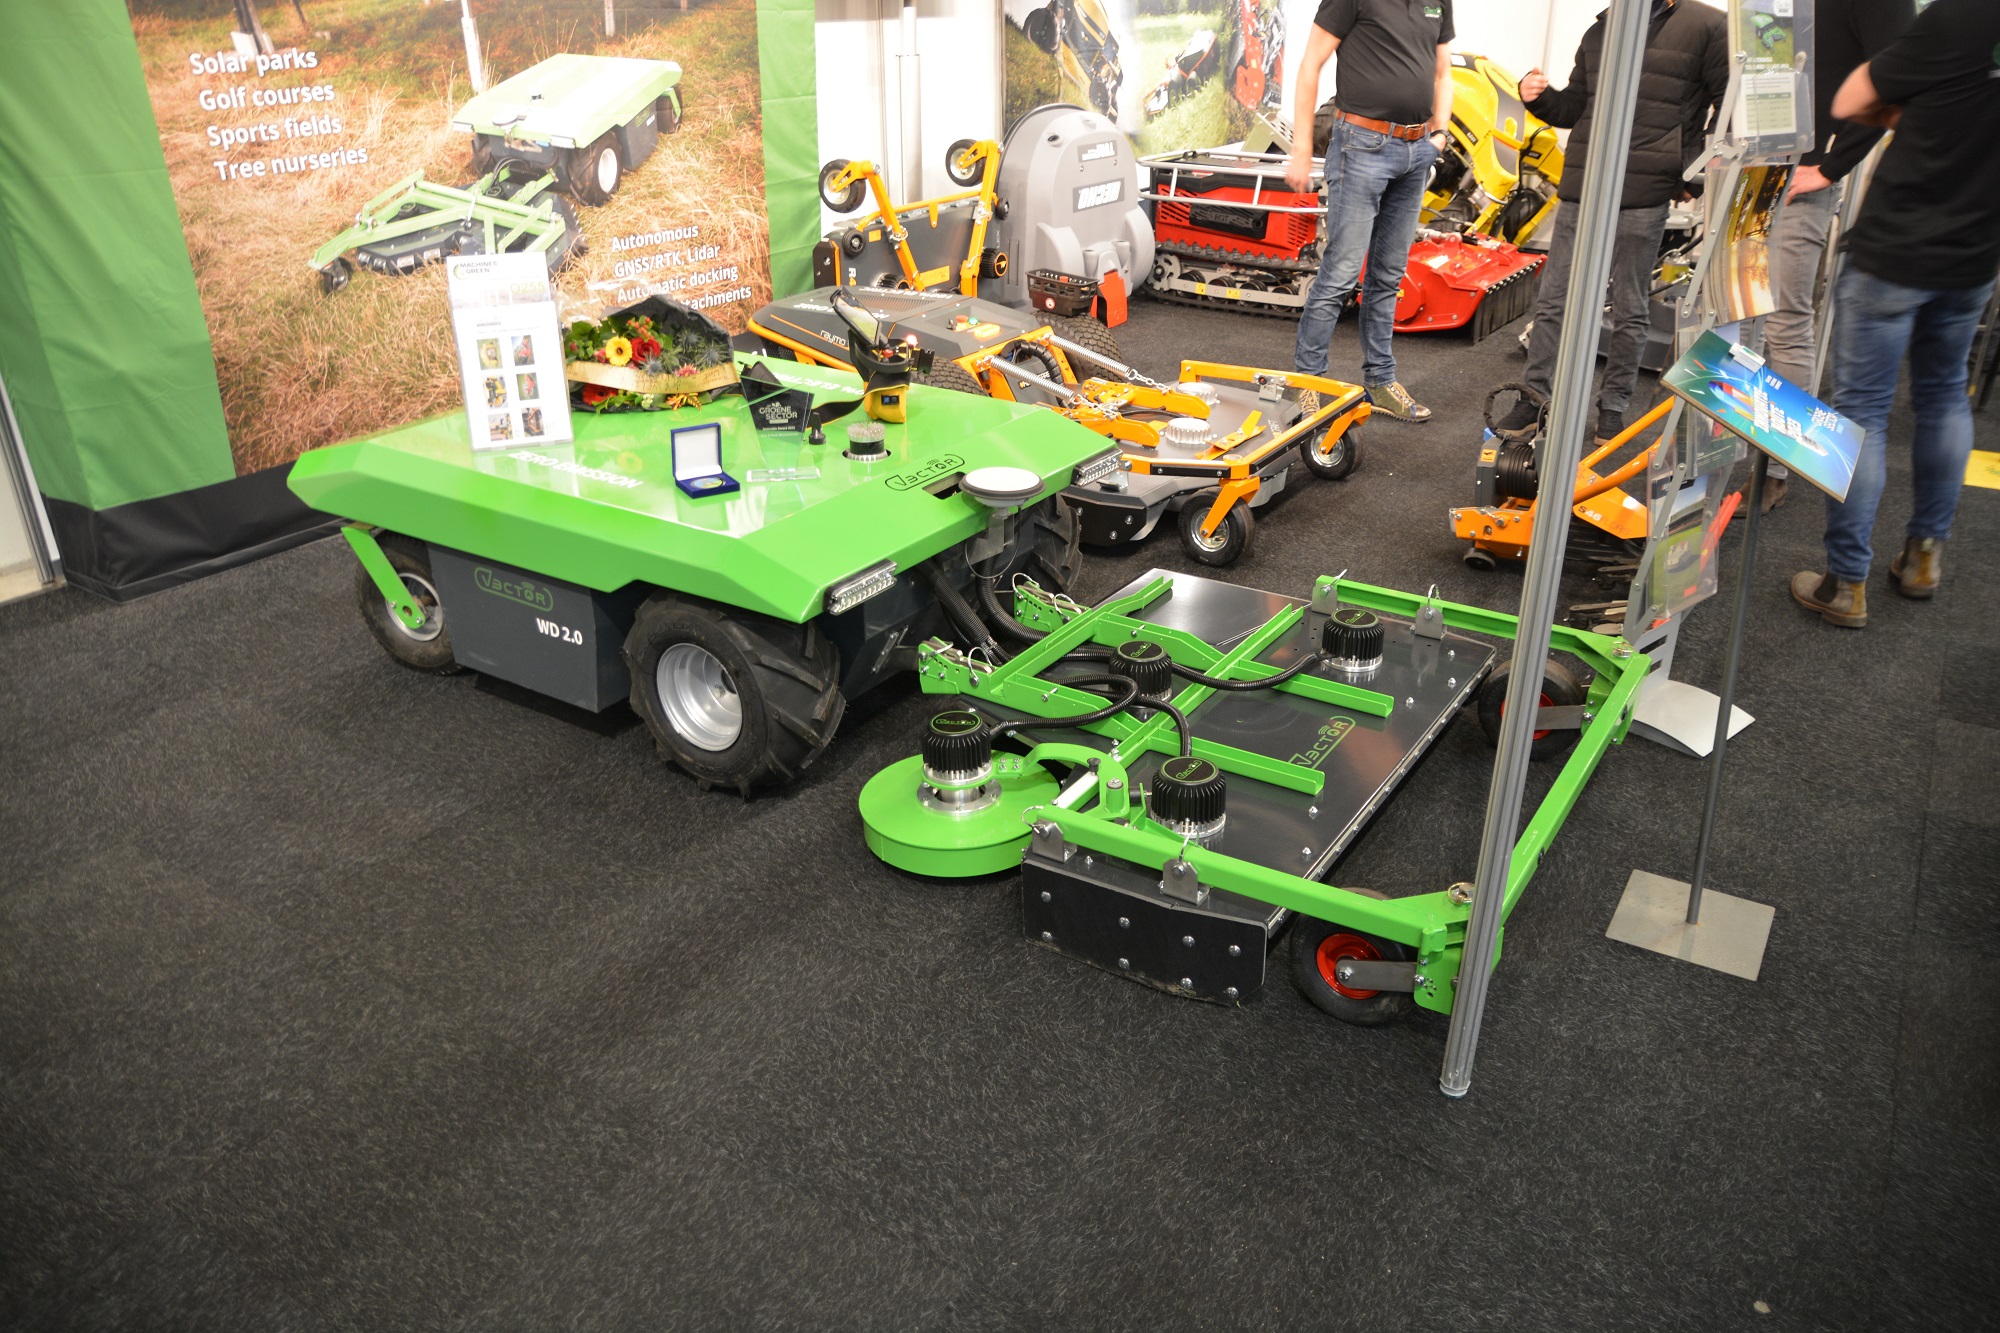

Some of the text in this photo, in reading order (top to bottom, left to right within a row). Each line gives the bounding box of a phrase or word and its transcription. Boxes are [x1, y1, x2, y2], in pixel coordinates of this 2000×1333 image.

[190, 47, 318, 77] Solar parks
[199, 84, 335, 111] Golf courses
[207, 113, 343, 151] Sports fields
[213, 146, 368, 181] Tree nurseries
[1214, 212, 1228, 223] HOT
[611, 225, 699, 253] Autonomous
[614, 245, 721, 278] GNSS/RTK, Lidar
[689, 265, 739, 287] docking
[819, 329, 847, 347] raymo
[759, 406, 792, 414] GROENE
[765, 412, 798, 420] SECTOR
[1770, 403, 1786, 435] ROUTE
[508, 450, 644, 488] ZERO EMISSION
[536, 617, 583, 646] WD 2.0
